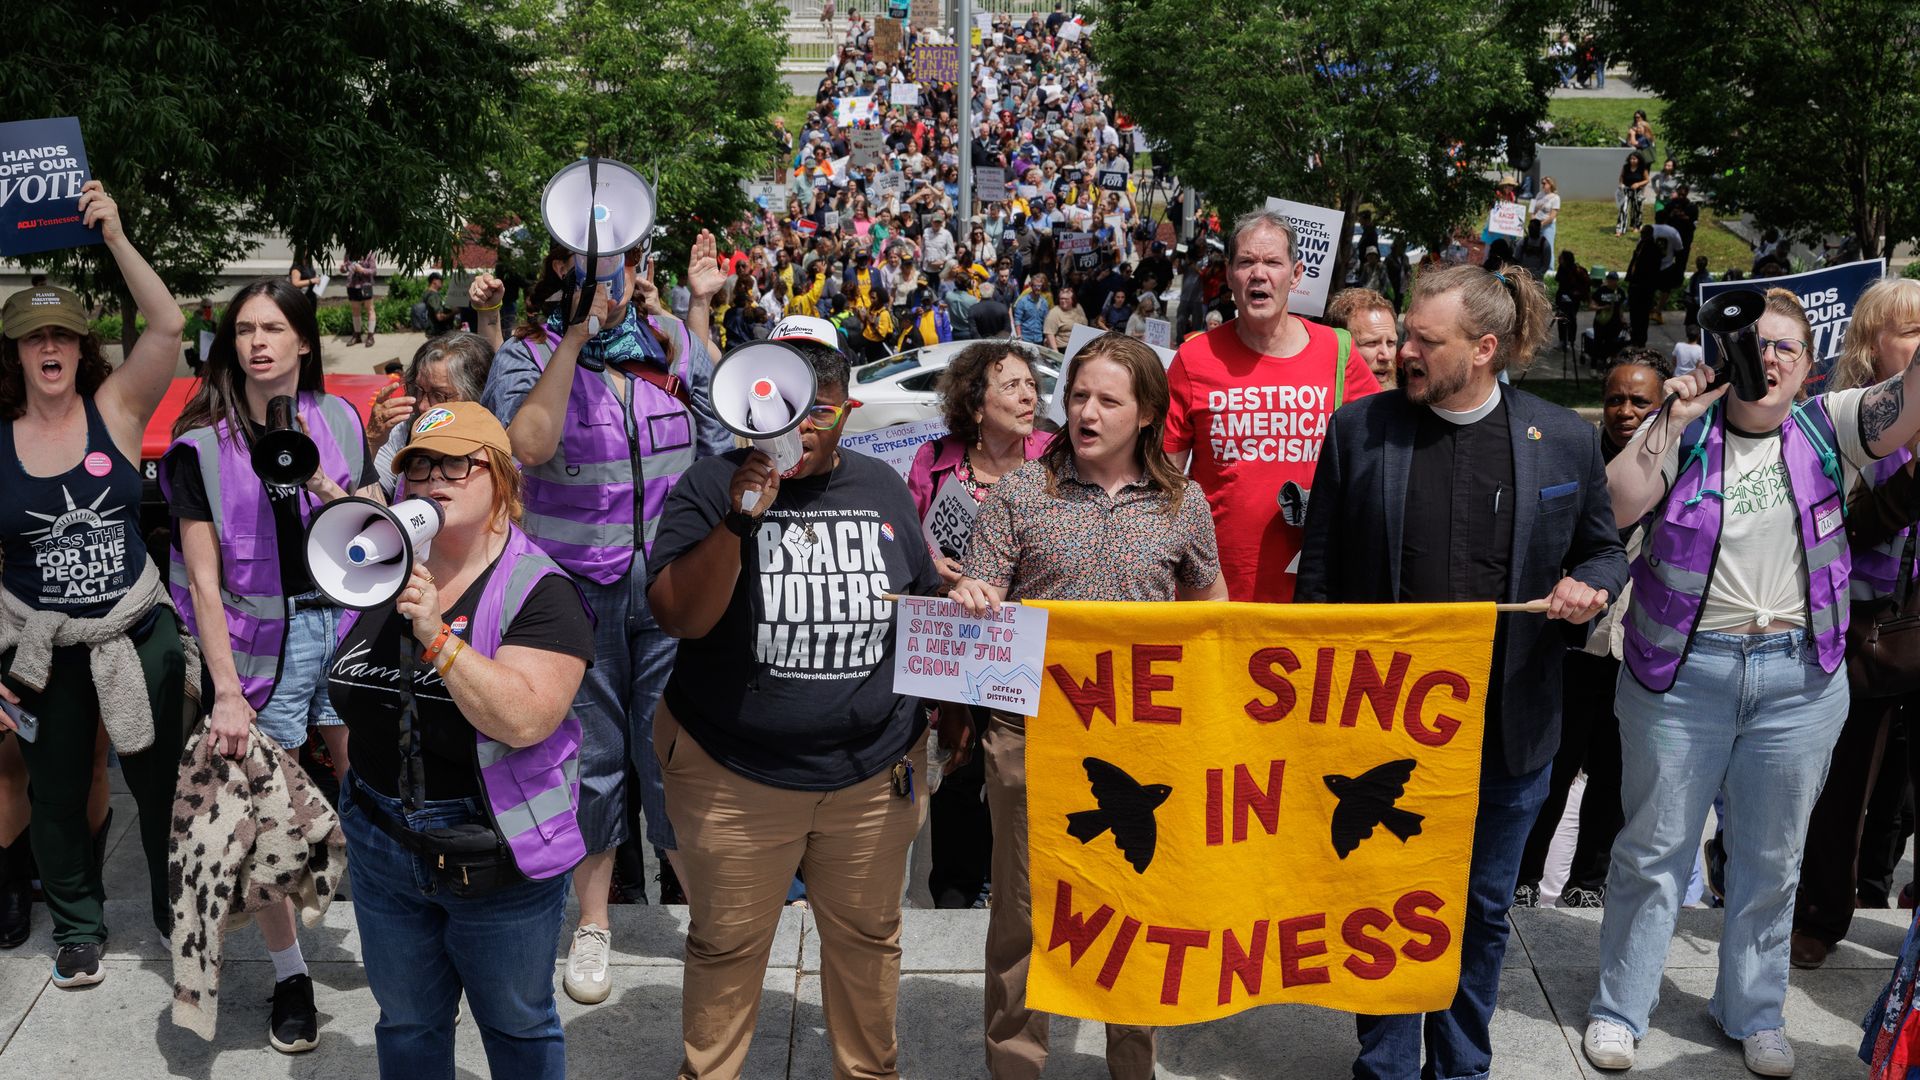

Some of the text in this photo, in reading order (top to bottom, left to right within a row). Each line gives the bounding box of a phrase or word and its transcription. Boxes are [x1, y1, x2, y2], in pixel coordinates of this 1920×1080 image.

[920, 48, 956, 60] RACISM
[927, 61, 937, 69] IN
[942, 61, 959, 70] THE
[2, 145, 69, 163] HANDS
[0, 157, 78, 177] OFF OUR
[0, 170, 84, 208] VOTE
[17, 215, 80, 229] ACLU Tennessee
[1797, 287, 1839, 309] NDS
[777, 323, 813, 336] Madtown
[1208, 385, 1328, 412] DESTROY
[885, 426, 916, 439] CHOOSE
[1209, 412, 1332, 437] AMERICA
[1210, 438, 1322, 462] FASCISM
[807, 510, 839, 518] MATTER.
[840, 510, 852, 518] WE
[853, 509, 881, 518] MATTER.
[939, 499, 959, 528] NO
[946, 495, 960, 515] THE
[1731, 495, 1769, 516] ADULT
[410, 513, 426, 529] PYLE
[31, 524, 125, 554] PASS THE
[35, 538, 126, 567] FOR THE
[42, 554, 125, 582] PEOPLE
[64, 575, 110, 598] ACT
[760, 573, 892, 623] VOTERS
[909, 618, 1014, 643] SAYS NO TO
[756, 622, 890, 669] MATTER
[907, 636, 1012, 663] A NEW JIM
[908, 655, 960, 677] CROW
[986, 693, 1026, 705] DISTRICT 9
[992, 685, 1022, 695] DEFEND
[1046, 643, 1471, 747] WE SING
[1206, 759, 1286, 847] IN
[1048, 879, 1452, 1006] WITNESS
